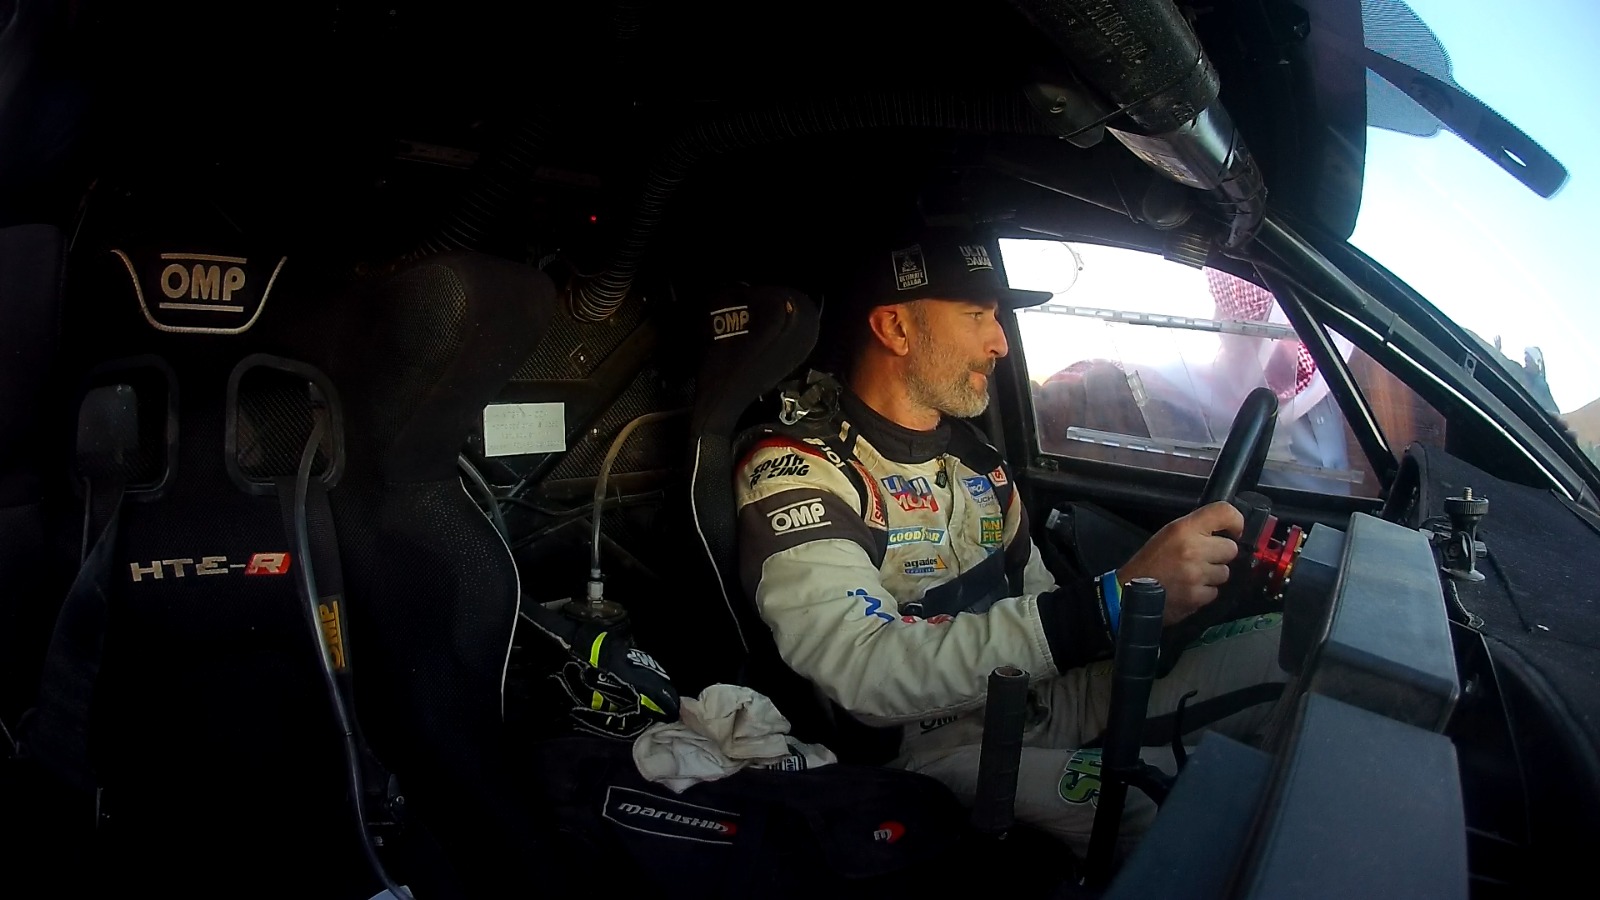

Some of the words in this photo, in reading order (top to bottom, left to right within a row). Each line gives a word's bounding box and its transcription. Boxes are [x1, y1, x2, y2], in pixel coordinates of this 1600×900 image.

[160, 263, 246, 301] OMP
[713, 310, 750, 335] OMP
[750, 454, 805, 478] SOUTH
[771, 502, 826, 531] OMP
[319, 604, 341, 671] OMP
